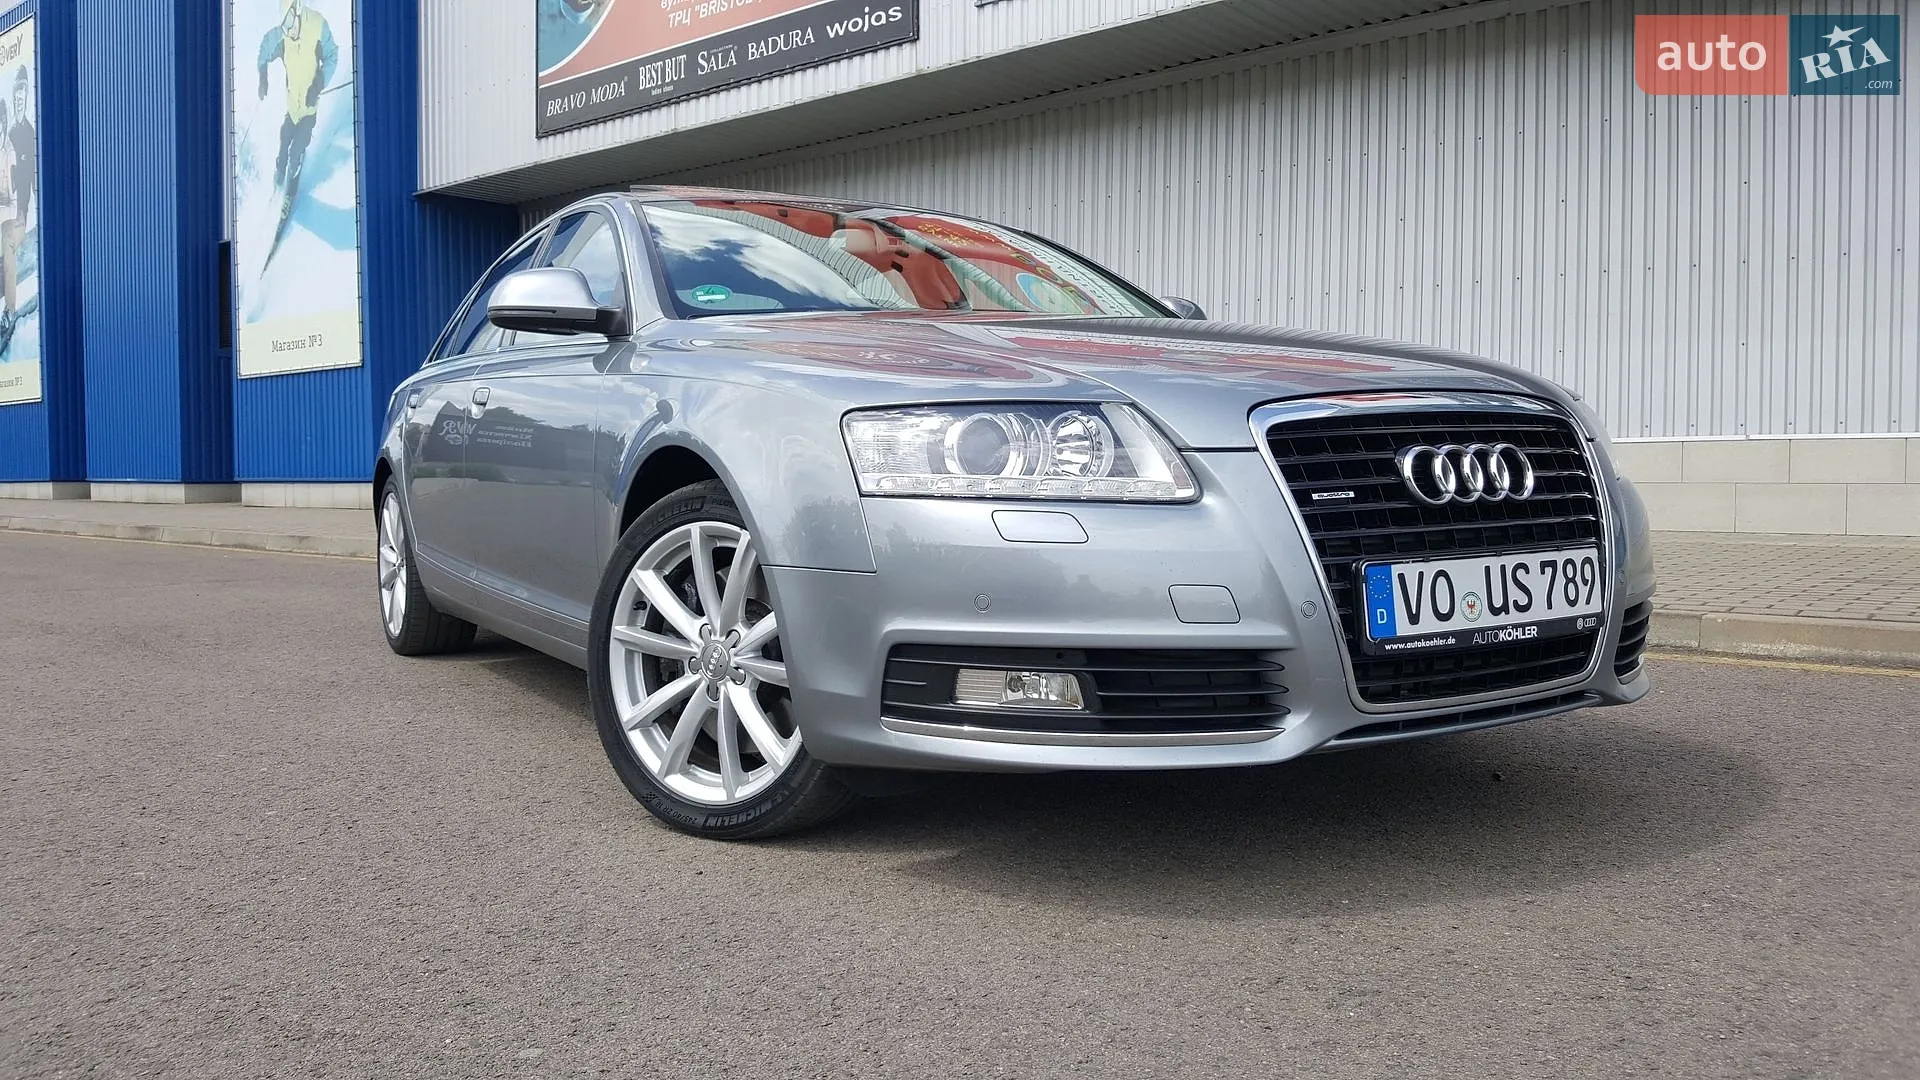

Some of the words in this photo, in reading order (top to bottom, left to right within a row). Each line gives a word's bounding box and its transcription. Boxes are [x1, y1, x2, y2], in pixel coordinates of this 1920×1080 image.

[669, 8, 692, 28] ТРЦ
[825, 6, 903, 39] wojas
[747, 26, 816, 61] BADURA
[639, 61, 664, 91] BEST
[665, 54, 687, 83] BUT
[697, 49, 737, 75] SALA
[546, 90, 586, 117] BRAVO
[590, 80, 626, 105] MODA
[271, 339, 306, 353] Магазин
[1397, 569, 1456, 626] VO
[1484, 562, 1534, 617] US
[1540, 556, 1597, 610] 789
[1376, 608, 1388, 624] D
[1384, 635, 1456, 651] www.autokoehler.de
[1472, 625, 1538, 645] AUTOKÖHLER
